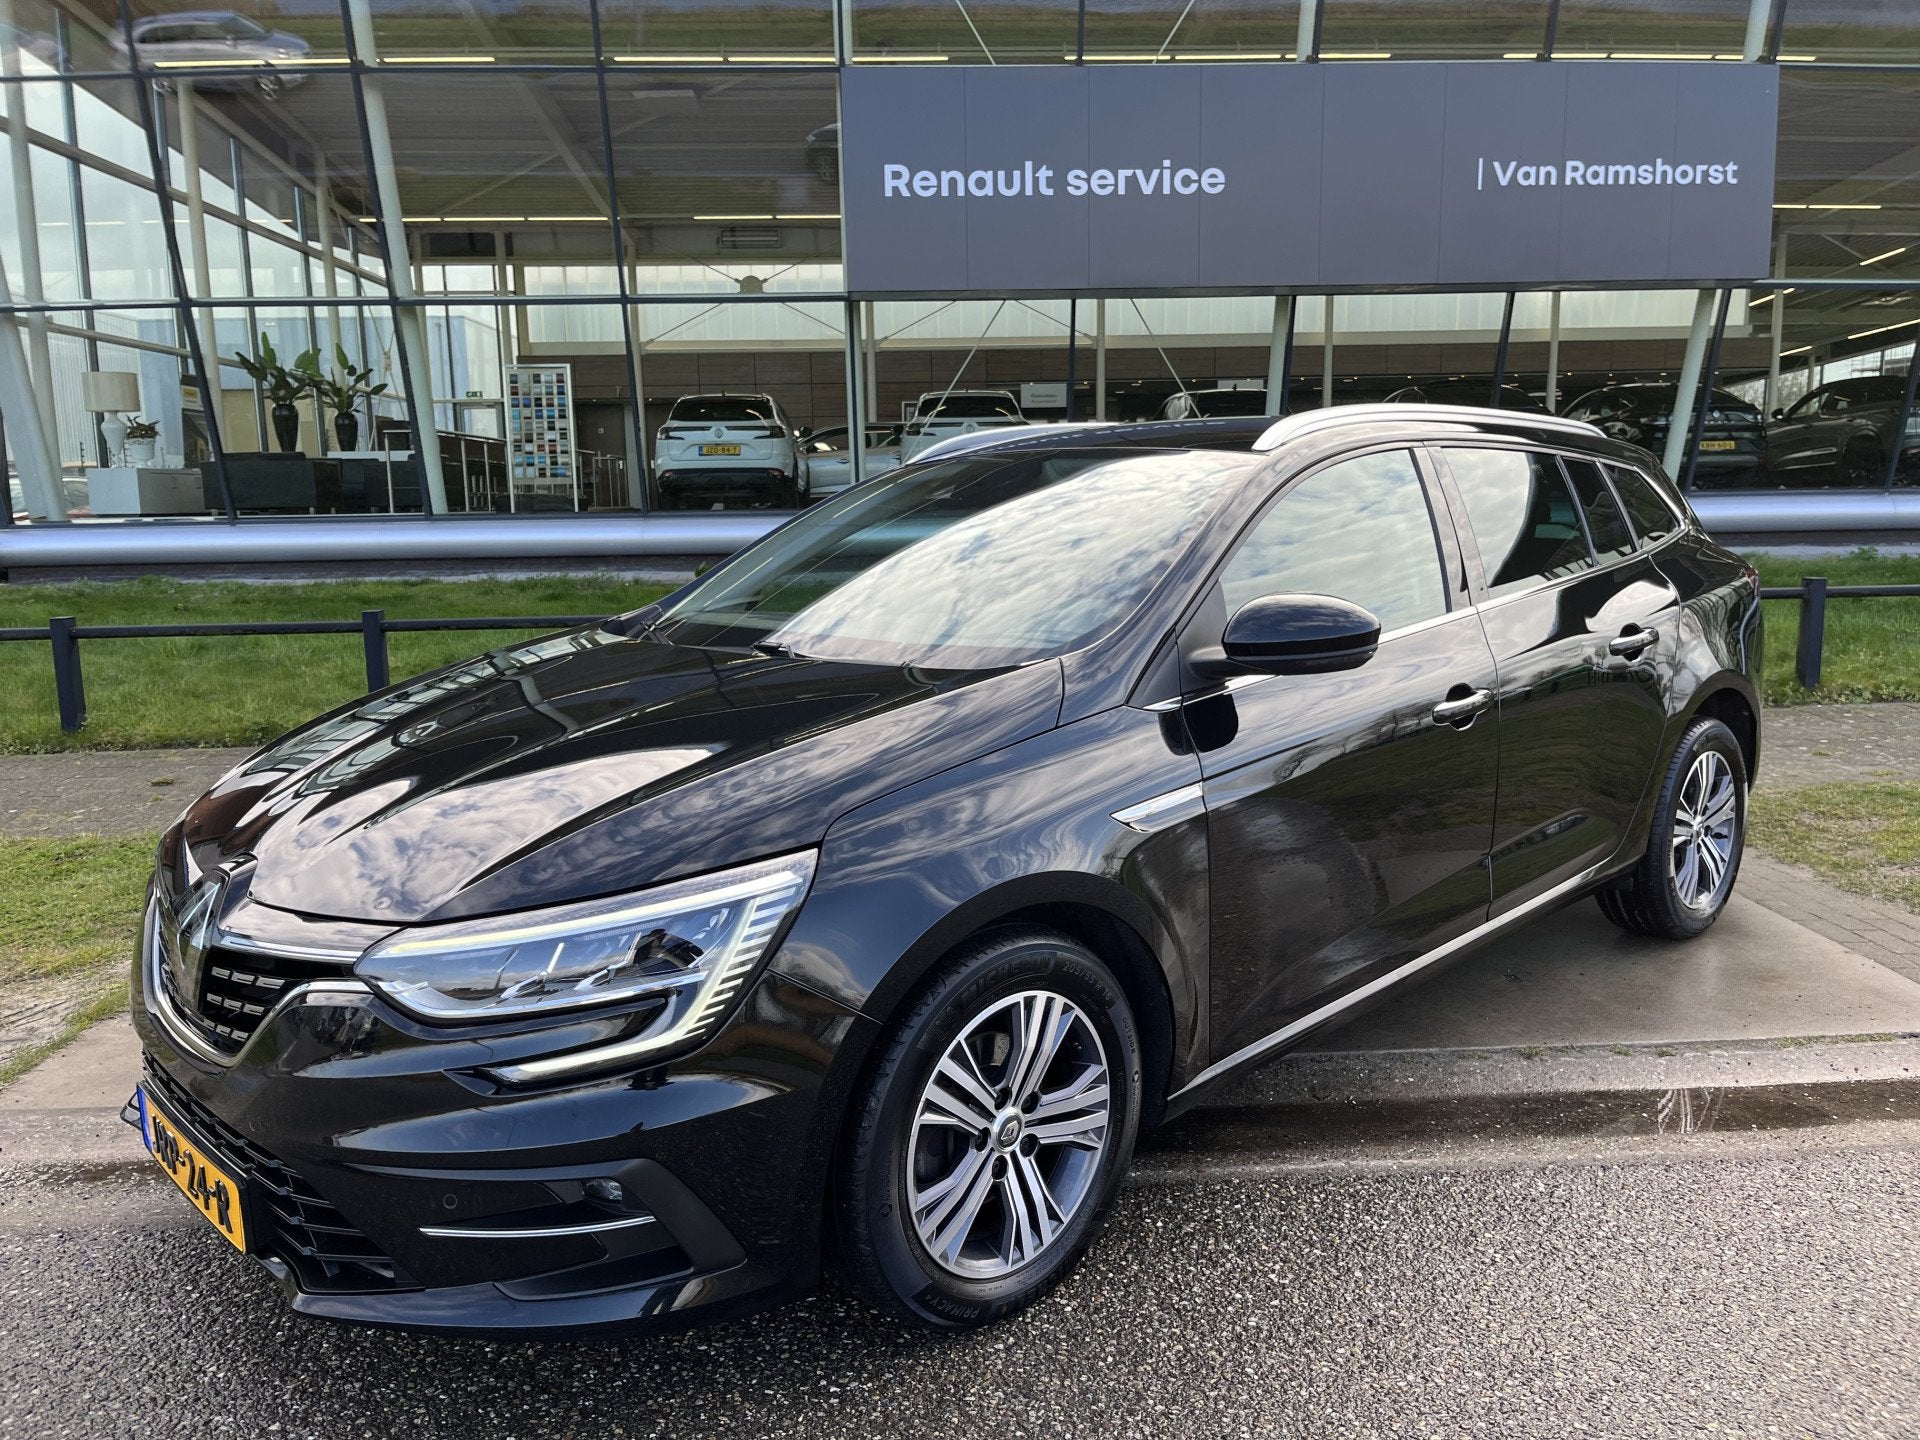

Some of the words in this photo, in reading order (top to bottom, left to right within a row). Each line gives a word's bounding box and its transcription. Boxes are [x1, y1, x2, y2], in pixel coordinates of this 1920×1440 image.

[883, 161, 1054, 197] Renault
[1066, 160, 1226, 196] service
[1492, 161, 1558, 187] Van
[1564, 158, 1739, 186] Ramshorst
[1062, 961, 1096, 984] 205/55
[1095, 980, 1104, 992] R
[1102, 988, 1113, 1001] 16
[1121, 1016, 1137, 1055] OUTSIDE
[929, 1296, 981, 1319] PRIMACY
